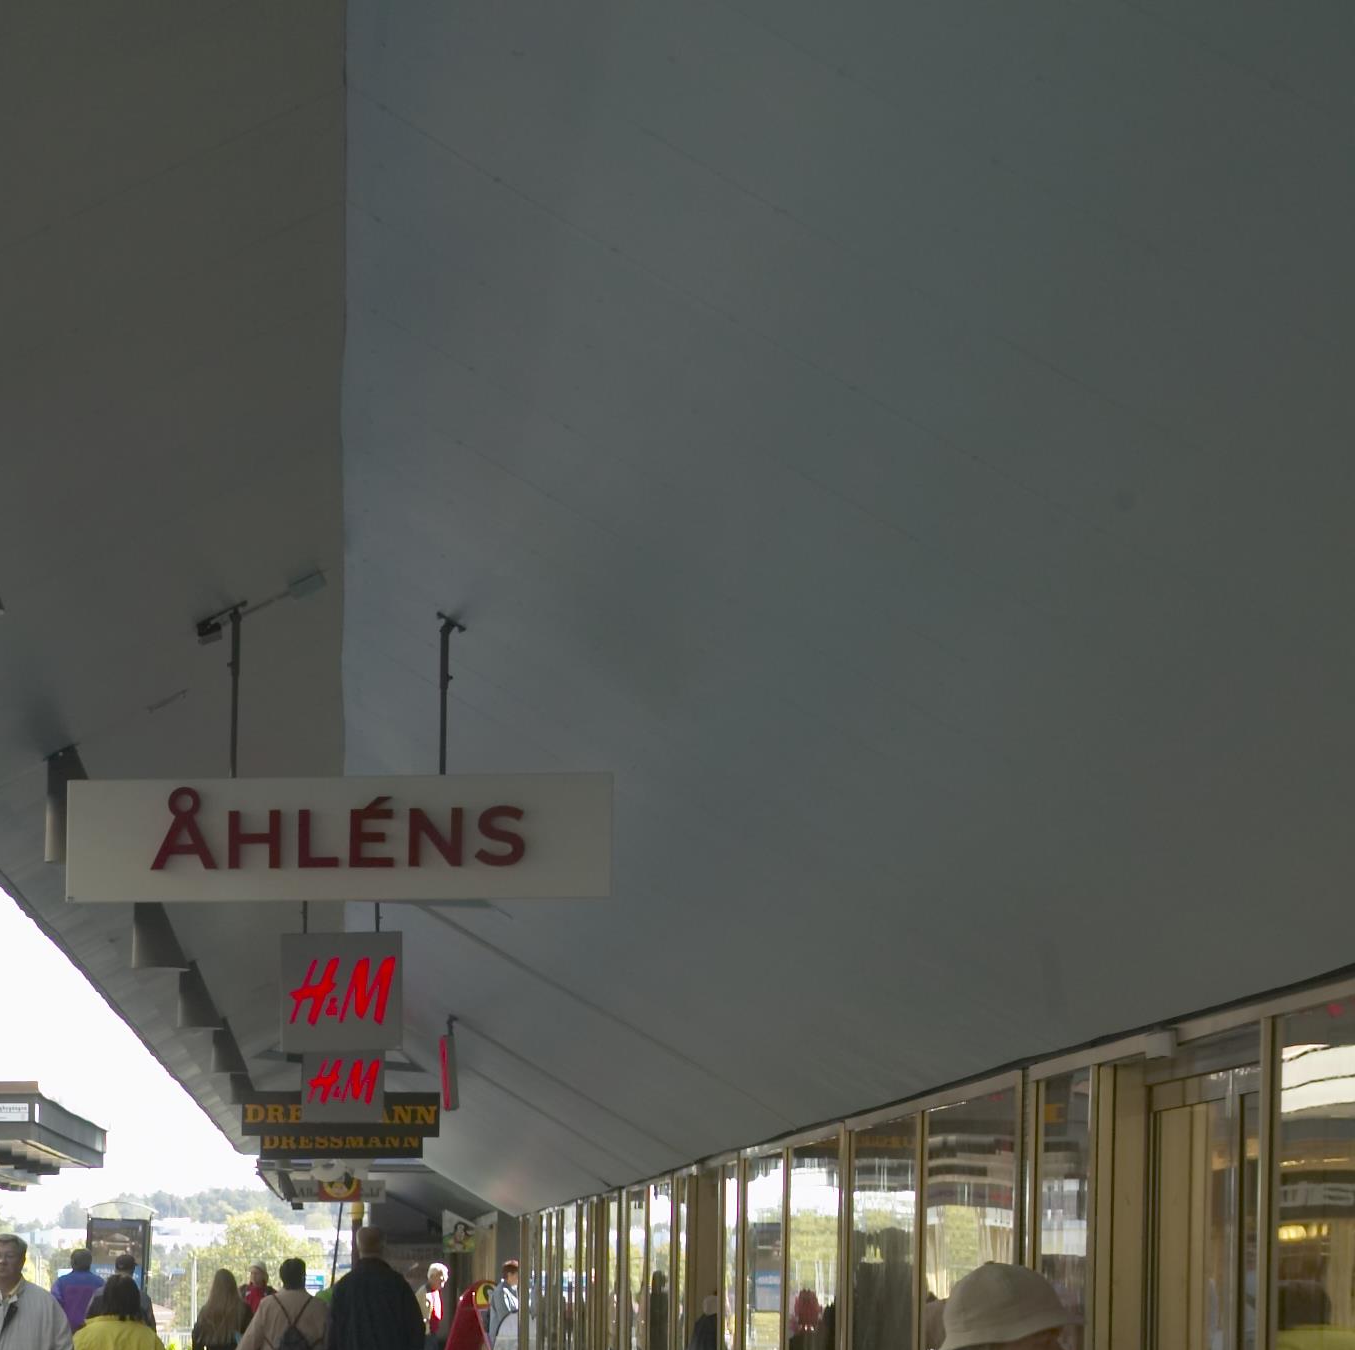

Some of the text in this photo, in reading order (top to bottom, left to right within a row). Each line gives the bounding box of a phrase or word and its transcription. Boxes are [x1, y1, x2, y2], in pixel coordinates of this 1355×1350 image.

[150, 786, 527, 870] ÅHLÉNS
[289, 956, 397, 1026] H&M
[306, 1058, 381, 1105] H&M
[263, 1136, 419, 1150] DRESSMANN
